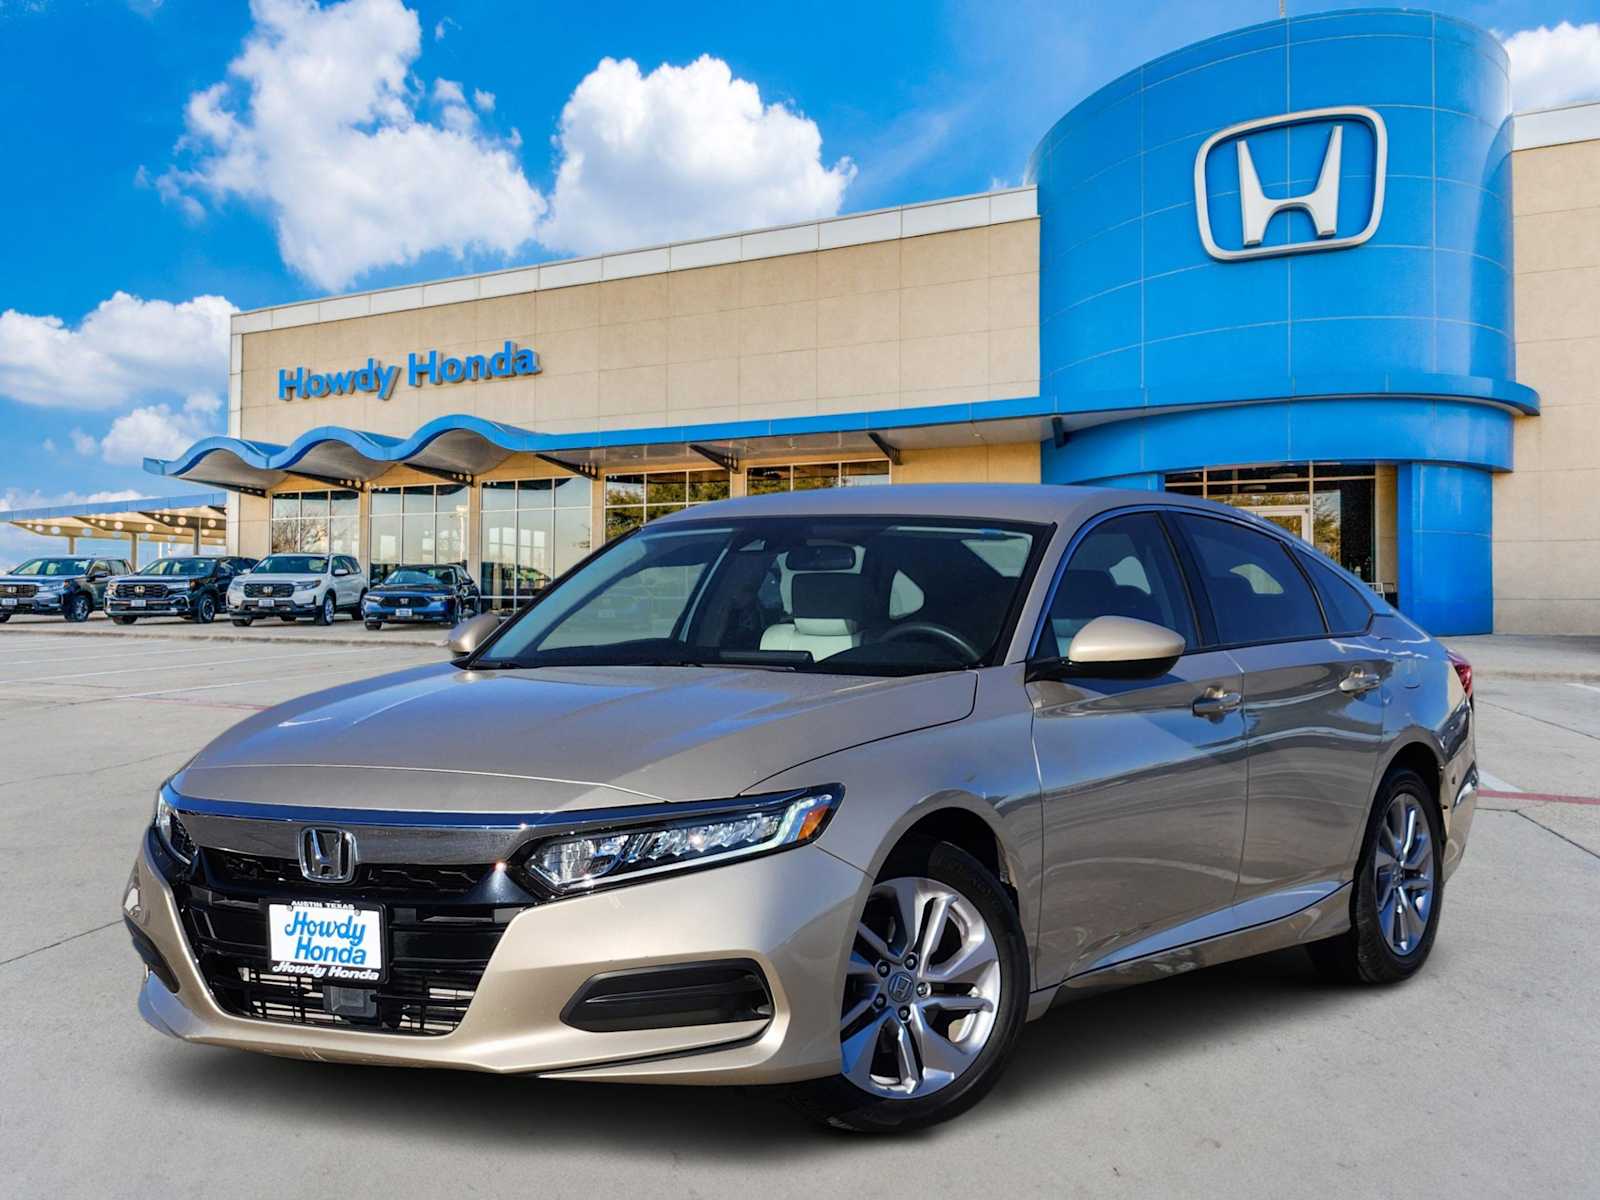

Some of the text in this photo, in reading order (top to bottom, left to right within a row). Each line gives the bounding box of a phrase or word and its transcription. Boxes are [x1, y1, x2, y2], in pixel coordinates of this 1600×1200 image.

[278, 340, 542, 401] Howdy Honda
[291, 900, 355, 910] AUSTIN TEXAS
[284, 911, 366, 946] Howdy
[294, 936, 367, 965] Honda
[271, 961, 380, 981] Howdy Honda
